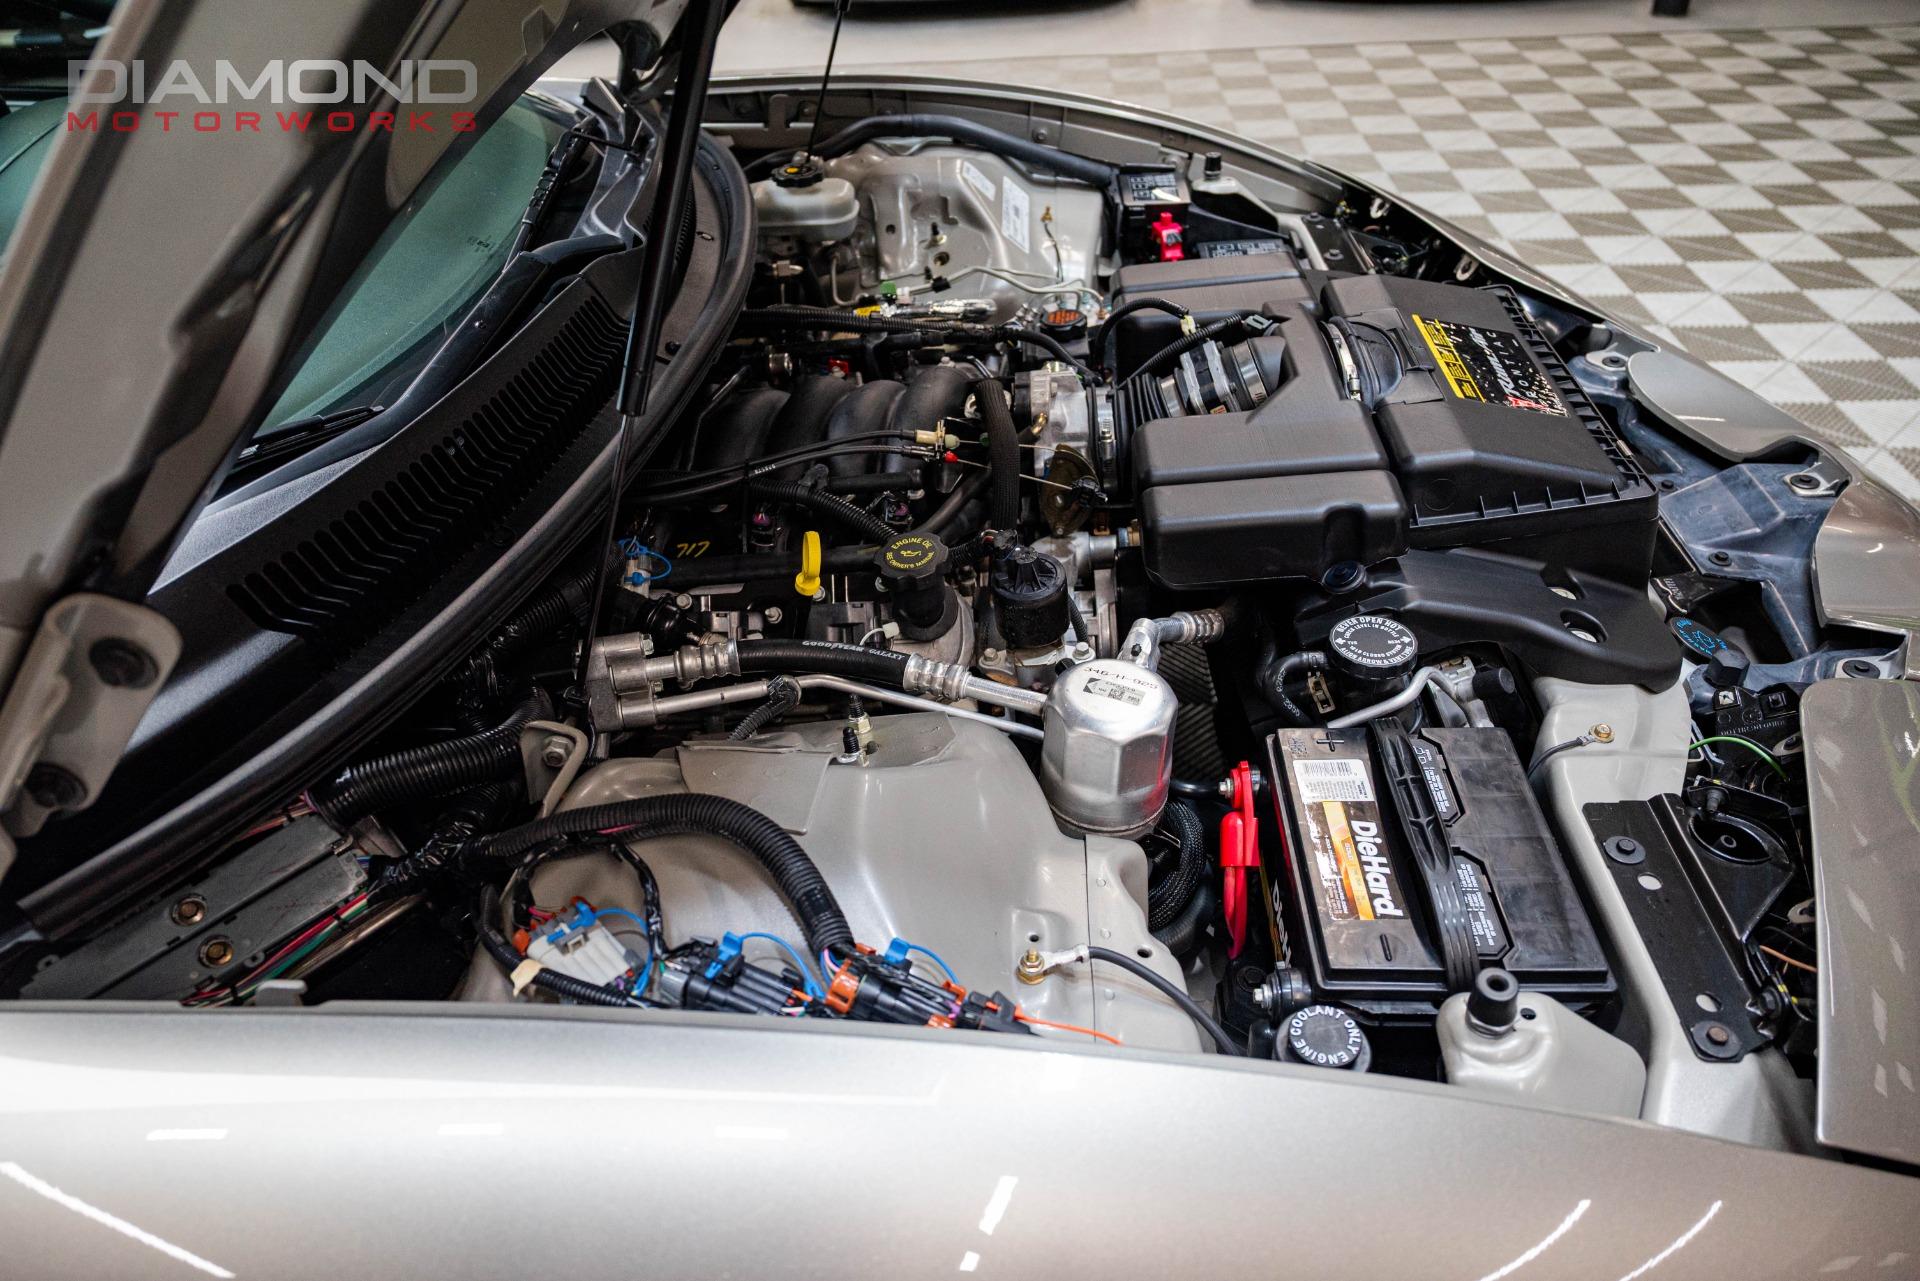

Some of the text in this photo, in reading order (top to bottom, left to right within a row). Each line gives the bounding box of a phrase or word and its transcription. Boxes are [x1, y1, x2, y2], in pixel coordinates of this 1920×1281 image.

[1485, 331, 1538, 399] PONTIAC
[677, 541, 711, 559] 717
[891, 537, 923, 550] ENGINE
[1336, 616, 1403, 633] NEVER OPEN HOT
[801, 640, 906, 660] GOODYEAR GALAXY
[1358, 656, 1382, 665] ARROW
[1350, 820, 1404, 918] DieHard
[1290, 1005, 1362, 1065] ENGINE COOLANT ONLY
